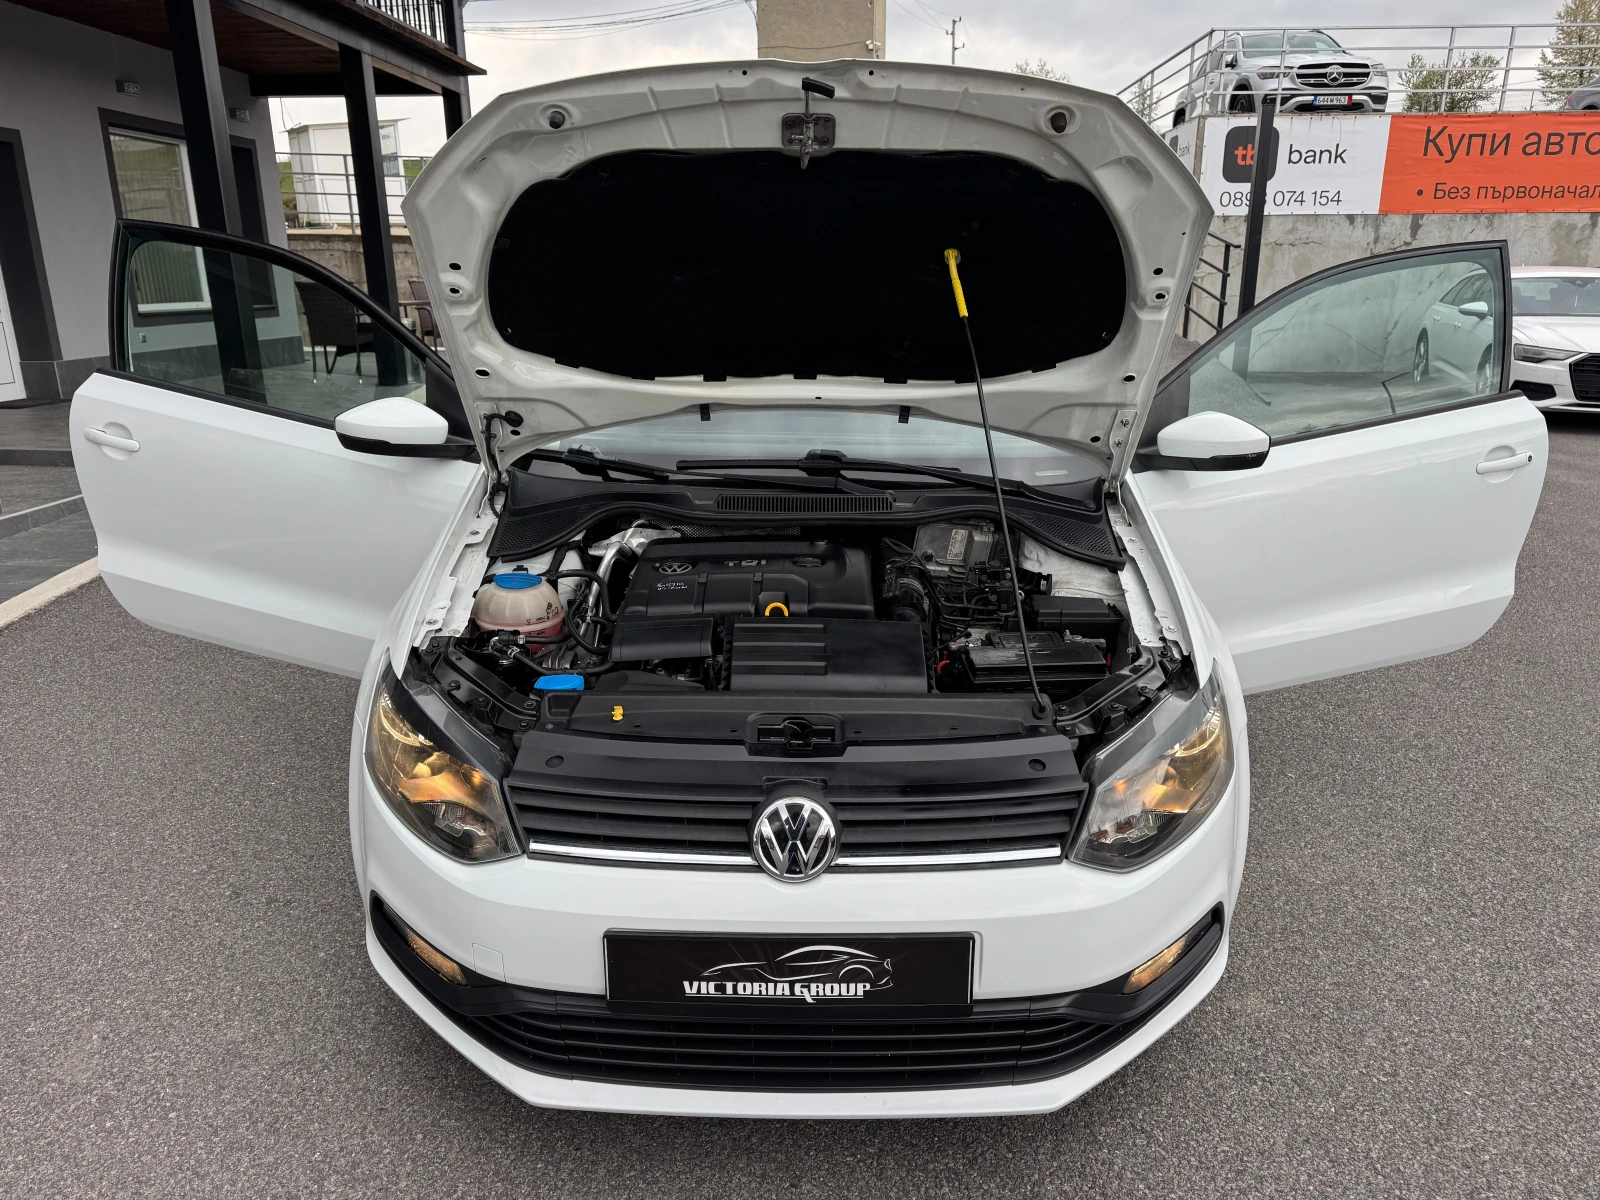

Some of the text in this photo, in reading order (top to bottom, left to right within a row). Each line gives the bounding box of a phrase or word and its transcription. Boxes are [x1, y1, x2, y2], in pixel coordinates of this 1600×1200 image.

[1287, 143, 1348, 165] bank
[1422, 126, 1600, 163] Купи авто
[1273, 190, 1306, 207] 074
[1311, 190, 1343, 206] 154
[1433, 182, 1600, 203] Без първоначал
[683, 981, 871, 1003] VICTORIA GROUP
